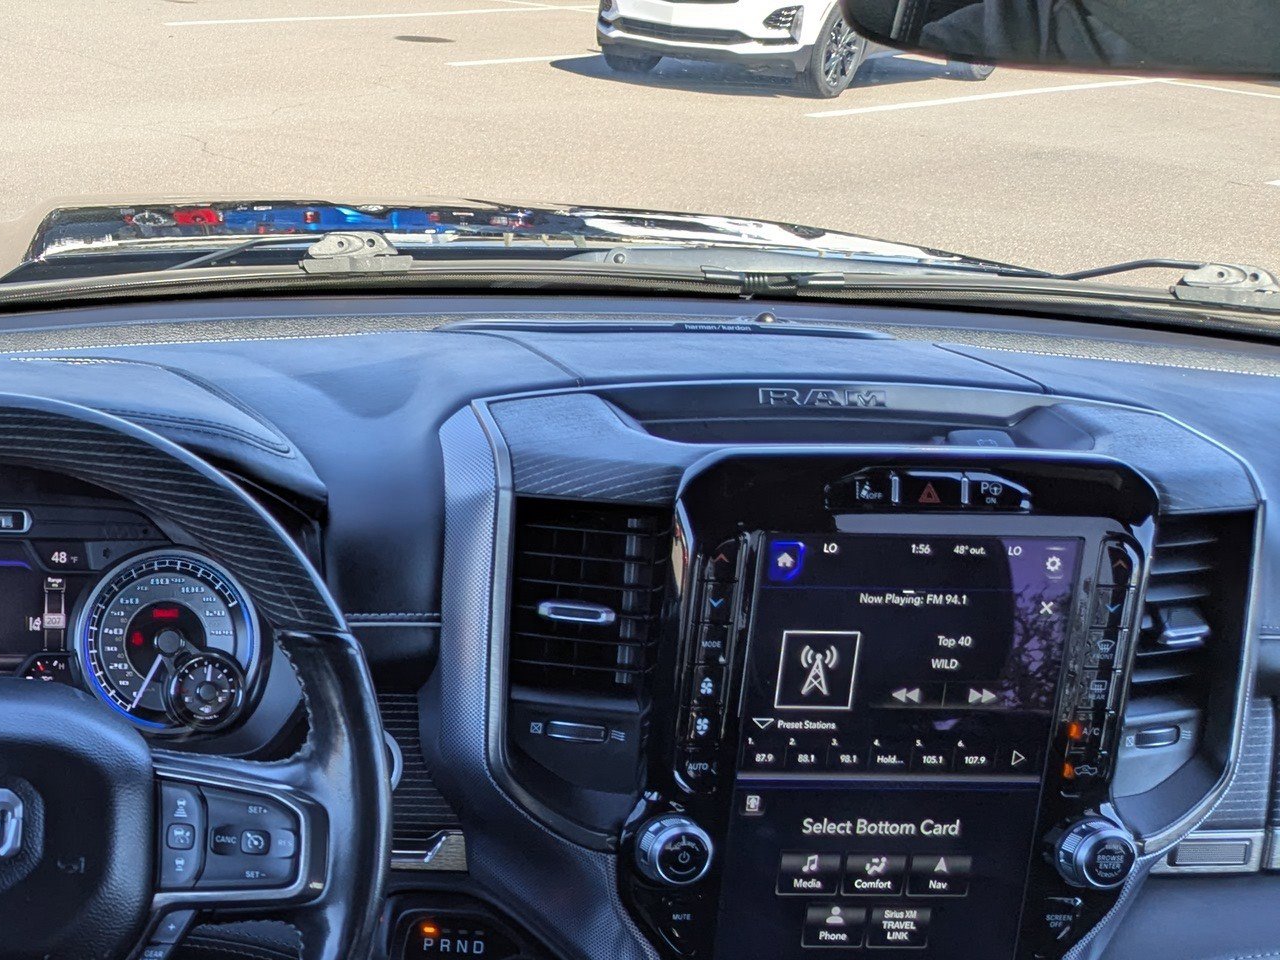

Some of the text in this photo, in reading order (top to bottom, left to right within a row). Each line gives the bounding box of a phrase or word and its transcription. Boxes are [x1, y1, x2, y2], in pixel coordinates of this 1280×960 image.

[758, 387, 887, 407] RAM
[869, 492, 882, 500] OFF
[823, 543, 838, 553] LO
[910, 544, 931, 554] 1:56
[954, 545, 986, 555] 48° out.
[1008, 546, 1022, 556] LO
[51, 551, 67, 564] 48
[860, 593, 967, 606] Now Playing: FM 94.1
[701, 640, 722, 648] MODE
[937, 635, 972, 647] Top 40
[931, 658, 959, 669] WILD
[778, 720, 837, 730] Preset Stations
[748, 737, 754, 745] 1.
[789, 737, 796, 746] 2.
[831, 738, 838, 746] 3.
[915, 739, 923, 747] 5.
[755, 753, 774, 762] 87.9
[797, 754, 815, 763] 88.1
[840, 754, 857, 763] 98.1
[876, 755, 904, 763] Hold...
[922, 755, 943, 763] 105.1
[964, 756, 986, 764] 107.9
[247, 805, 268, 814] SET+
[802, 817, 960, 836] Select Bottom Card
[215, 835, 237, 844] CANC
[793, 878, 822, 889] Media
[854, 879, 892, 889] Comfort
[929, 880, 947, 890] Nav
[884, 910, 917, 919] Sirius XM
[882, 921, 916, 930] TRAVEL
[818, 931, 847, 941] Phone
[886, 931, 909, 940] LINK
[423, 938, 485, 954] P R N D
